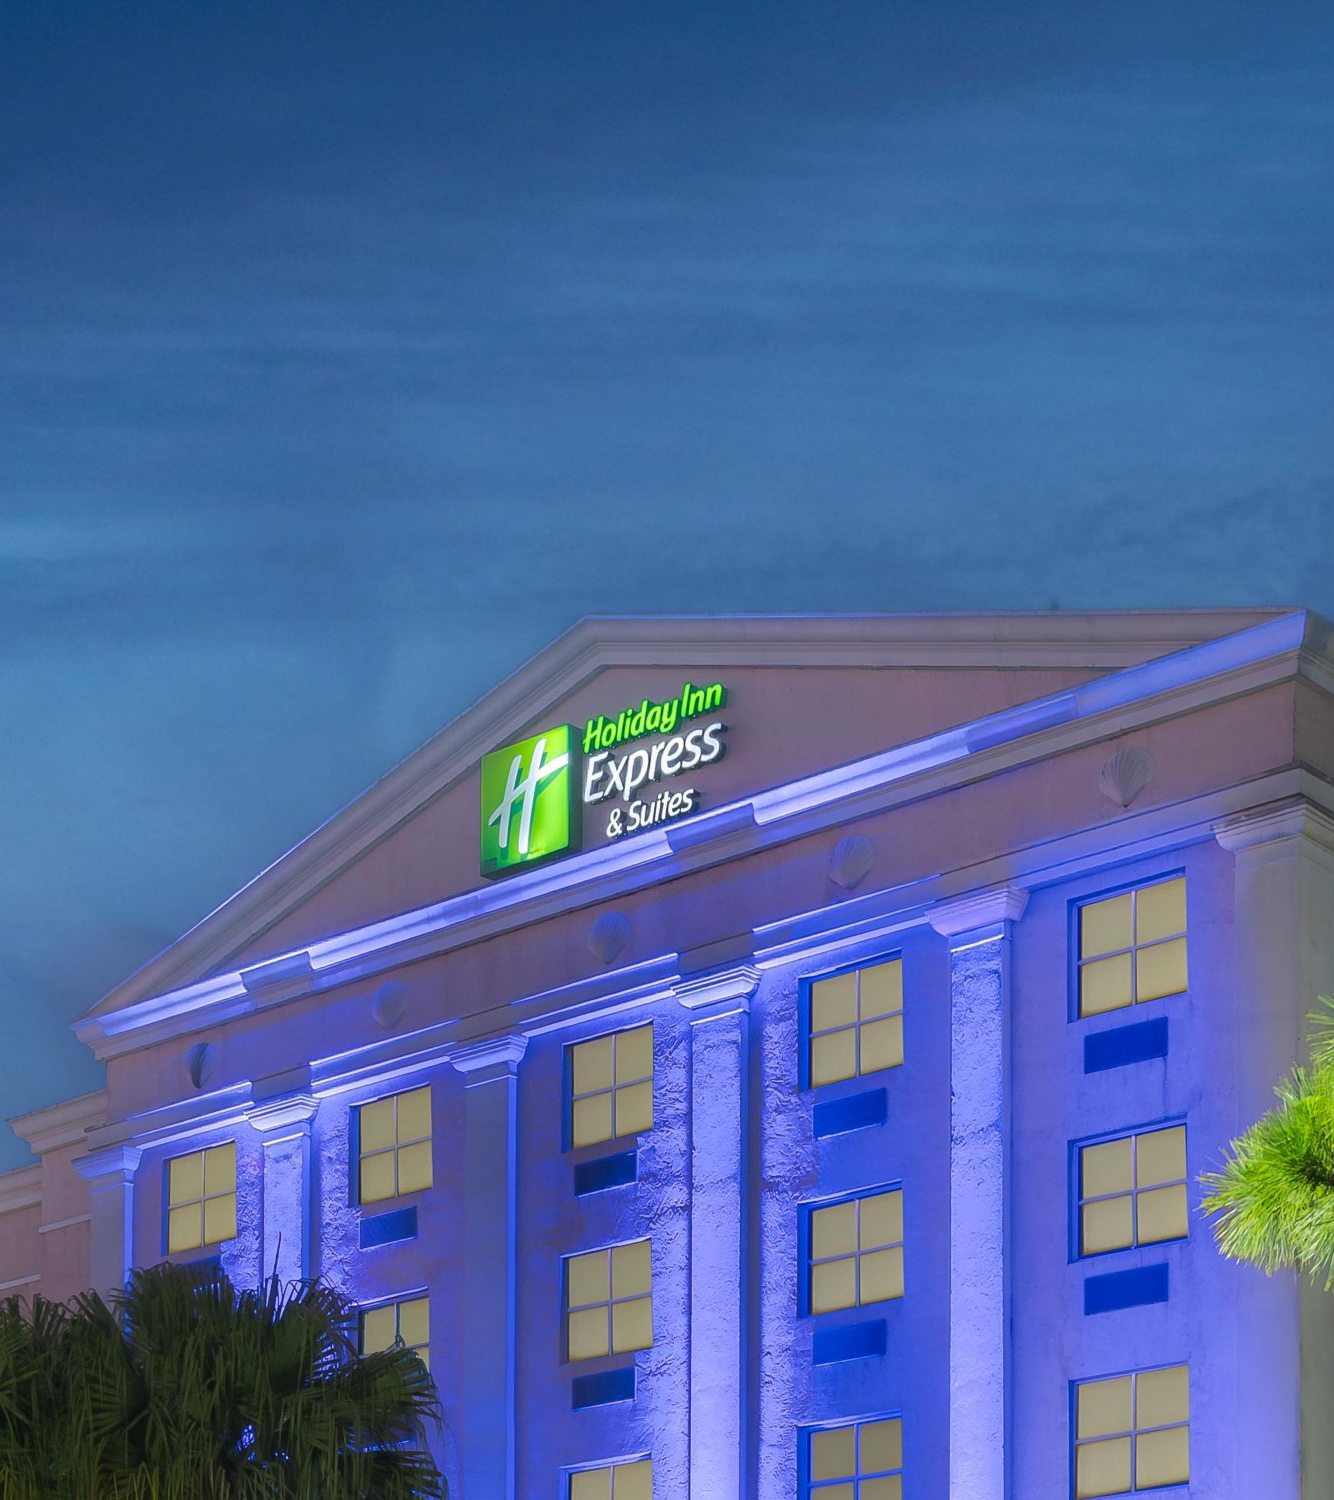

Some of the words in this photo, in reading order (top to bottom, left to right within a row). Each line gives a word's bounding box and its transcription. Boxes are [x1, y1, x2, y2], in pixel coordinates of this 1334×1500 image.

[583, 699, 679, 753] Holiday
[680, 682, 722, 717] Inn
[584, 723, 722, 803] Express
[606, 808, 623, 838] &
[627, 788, 695, 830] Suites
